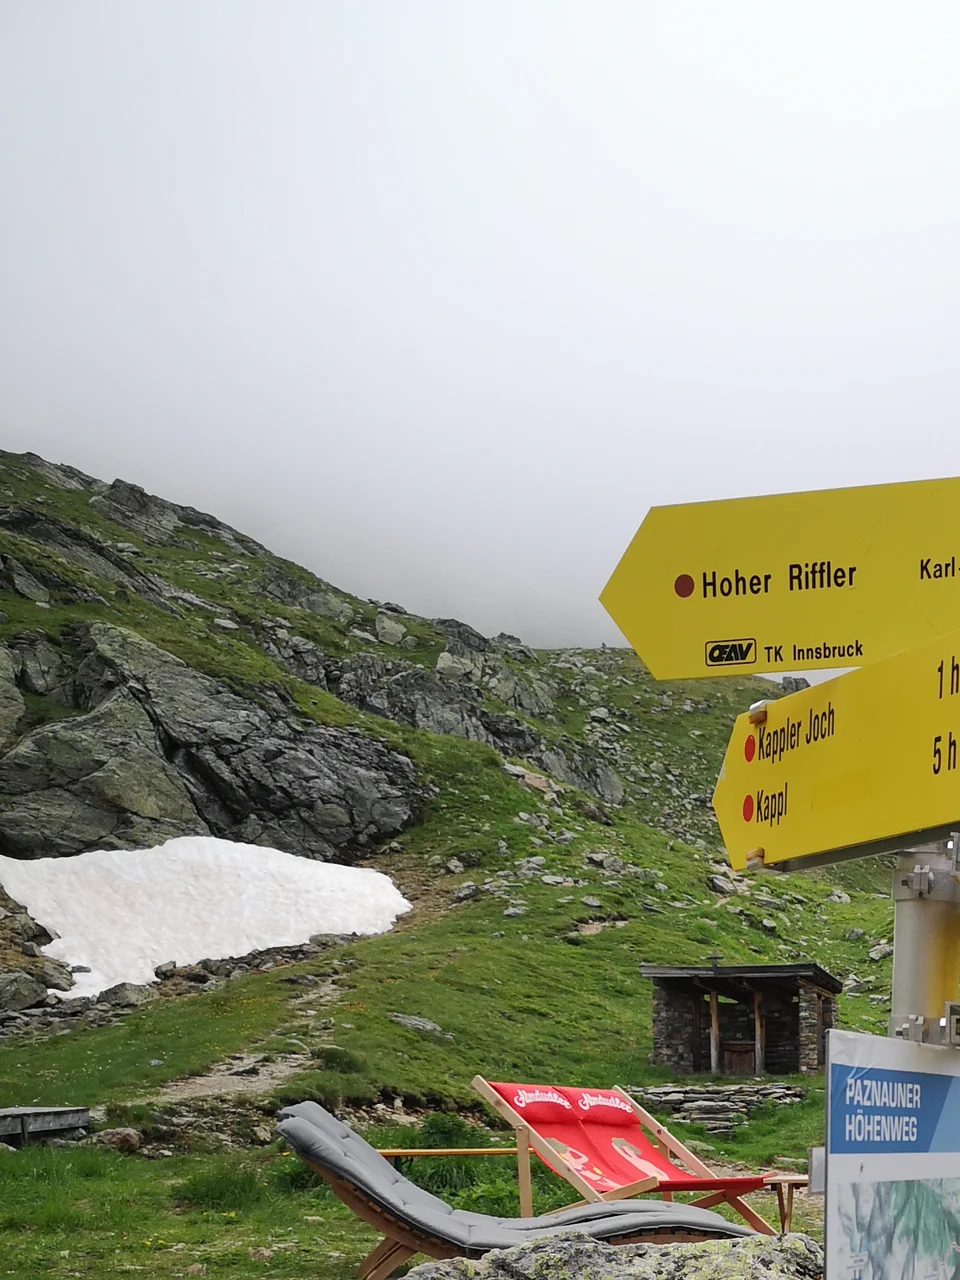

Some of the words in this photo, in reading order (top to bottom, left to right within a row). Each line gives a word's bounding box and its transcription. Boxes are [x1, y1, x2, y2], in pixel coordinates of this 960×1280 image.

[702, 569, 772, 599] Hoher
[789, 560, 857, 591] Riffler
[764, 645, 784, 663] TK
[792, 639, 863, 661] Innsbruck
[937, 660, 945, 699] 1
[950, 655, 960, 695] h
[757, 719, 803, 764] Kappler
[805, 701, 836, 744] Joch
[932, 735, 943, 775] 5
[947, 734, 957, 771] h
[756, 782, 788, 827] Kappl
[845, 1078, 921, 1109] PAZNAUNER
[845, 1109, 917, 1142] HÖHENWEG
